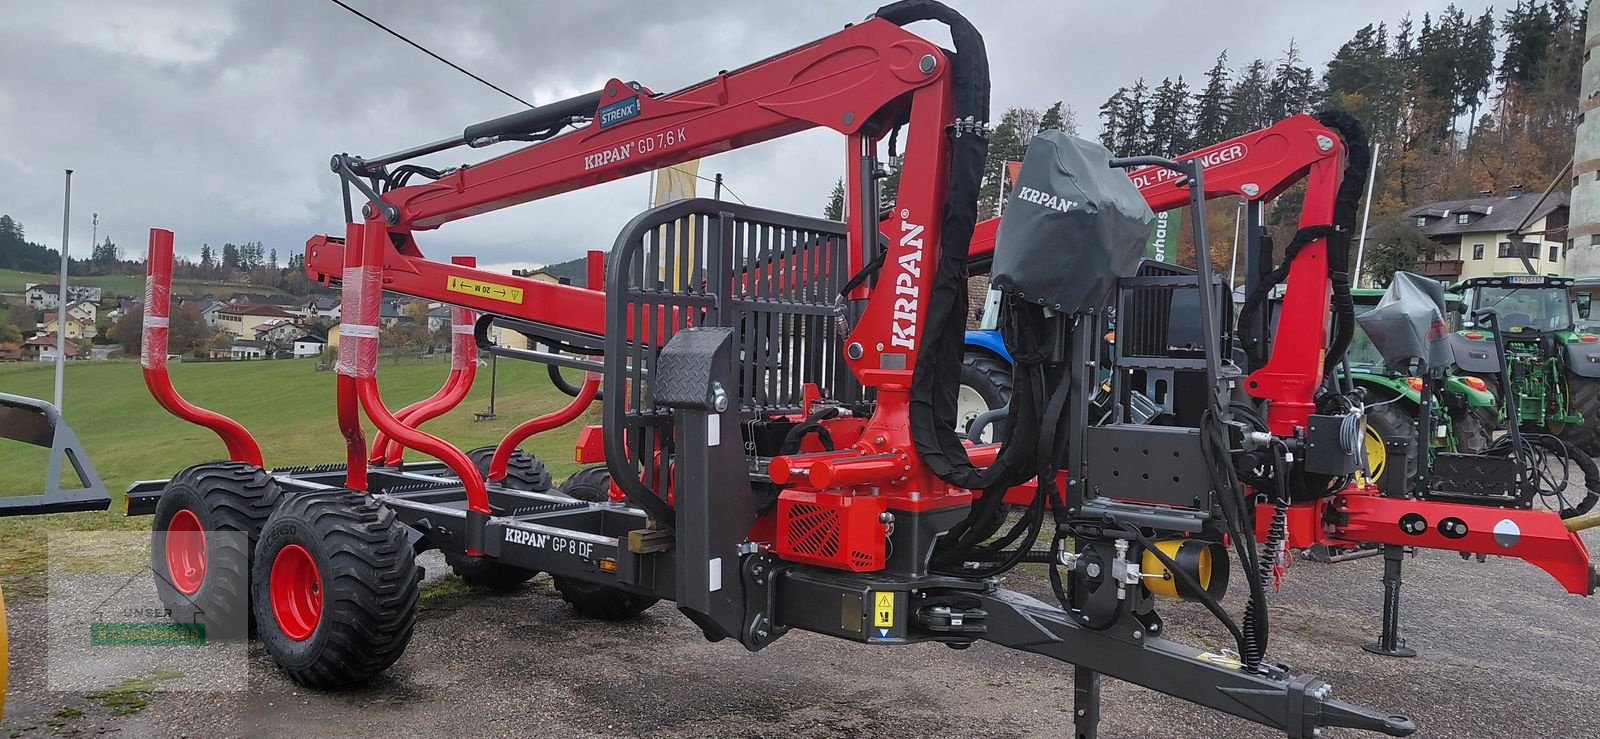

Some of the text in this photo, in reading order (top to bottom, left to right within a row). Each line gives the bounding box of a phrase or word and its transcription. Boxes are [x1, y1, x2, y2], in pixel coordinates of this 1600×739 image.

[602, 105, 632, 124] STRENX
[638, 137, 655, 153] GD
[657, 130, 675, 149] 7,6
[678, 127, 686, 142] K
[482, 285, 491, 293] 20
[552, 537, 567, 552] GP
[569, 540, 576, 555] 8
[579, 541, 594, 558] DF
